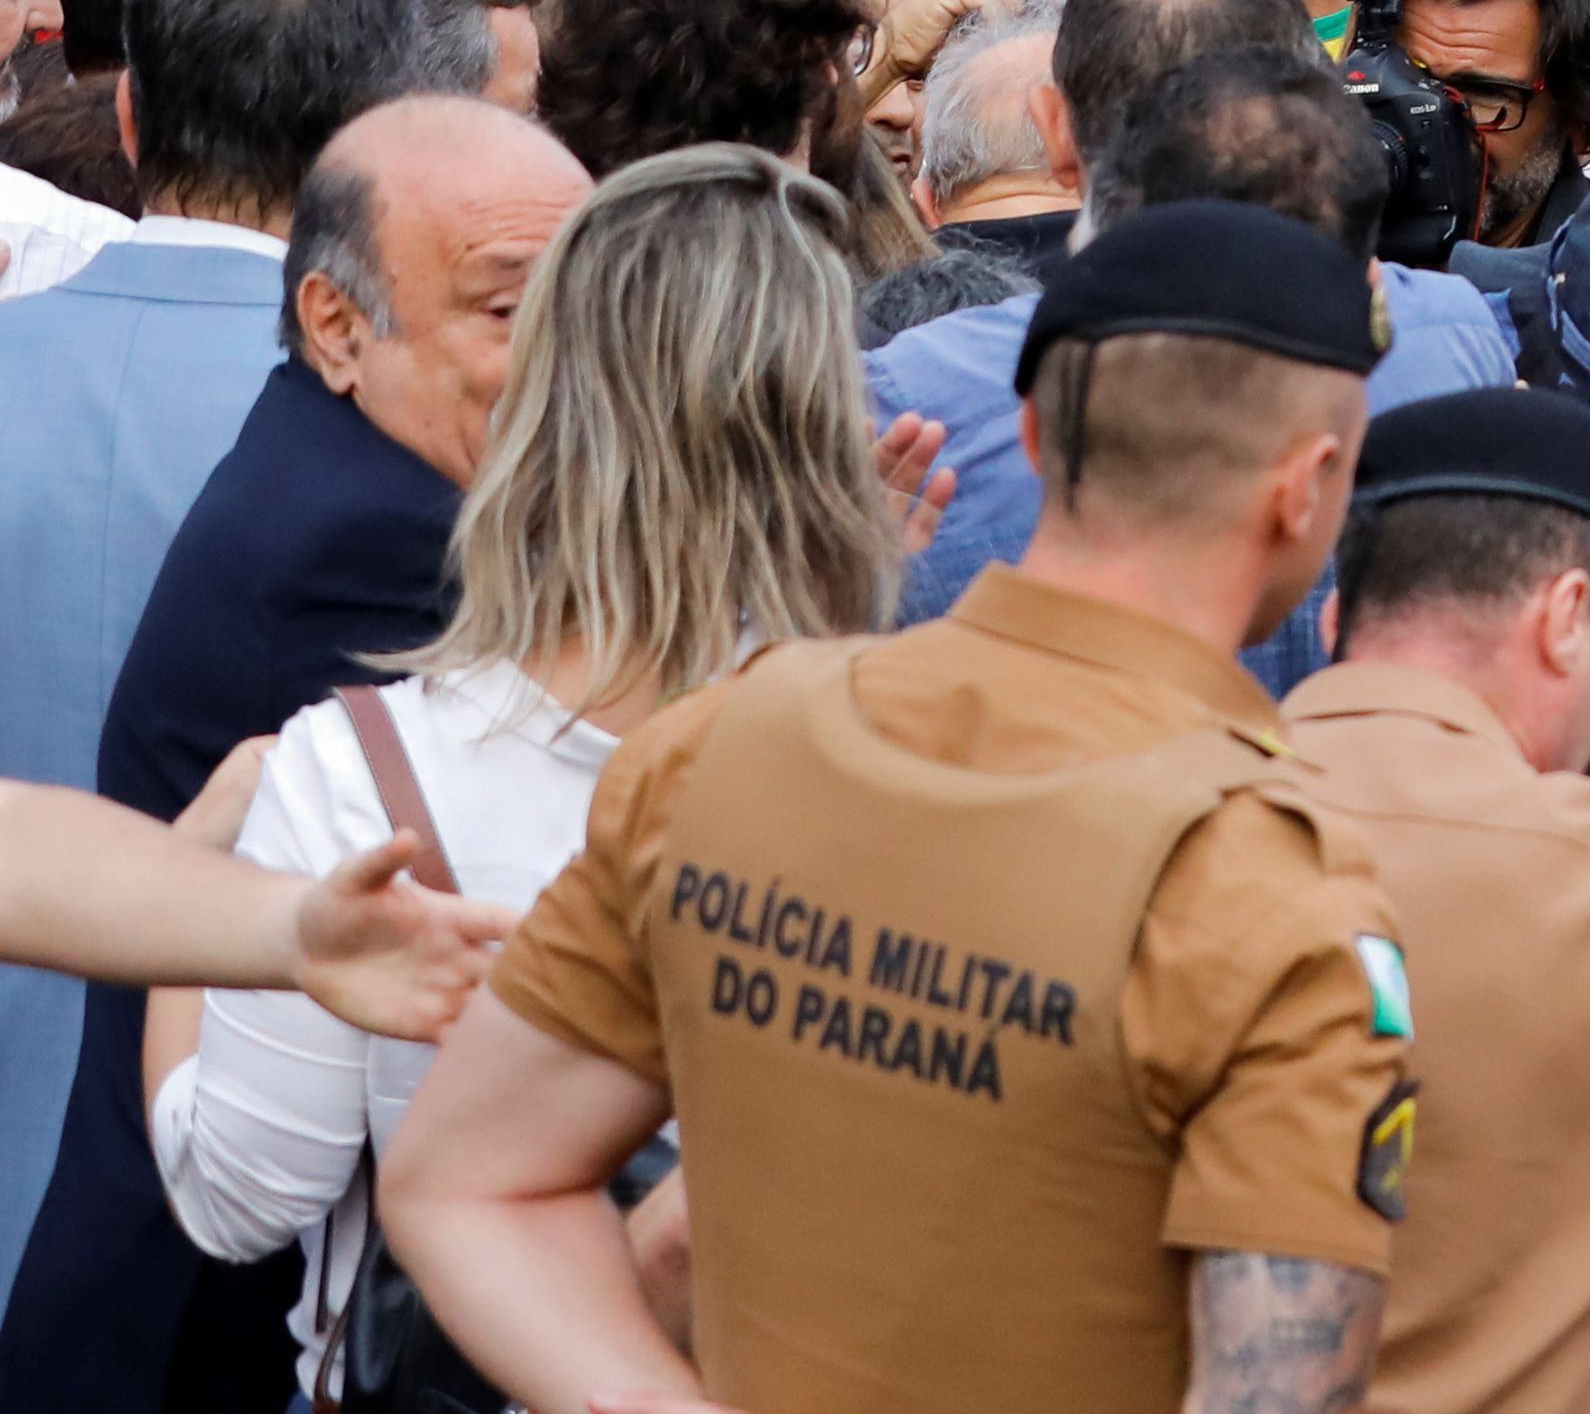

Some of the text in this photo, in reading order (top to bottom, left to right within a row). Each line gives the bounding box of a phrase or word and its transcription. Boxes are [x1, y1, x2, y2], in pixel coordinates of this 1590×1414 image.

[1342, 83, 1379, 94] Canon
[669, 862, 1079, 1049] POLÍCIA MILITAR
[711, 955, 1006, 1102] DO PARANÁ
